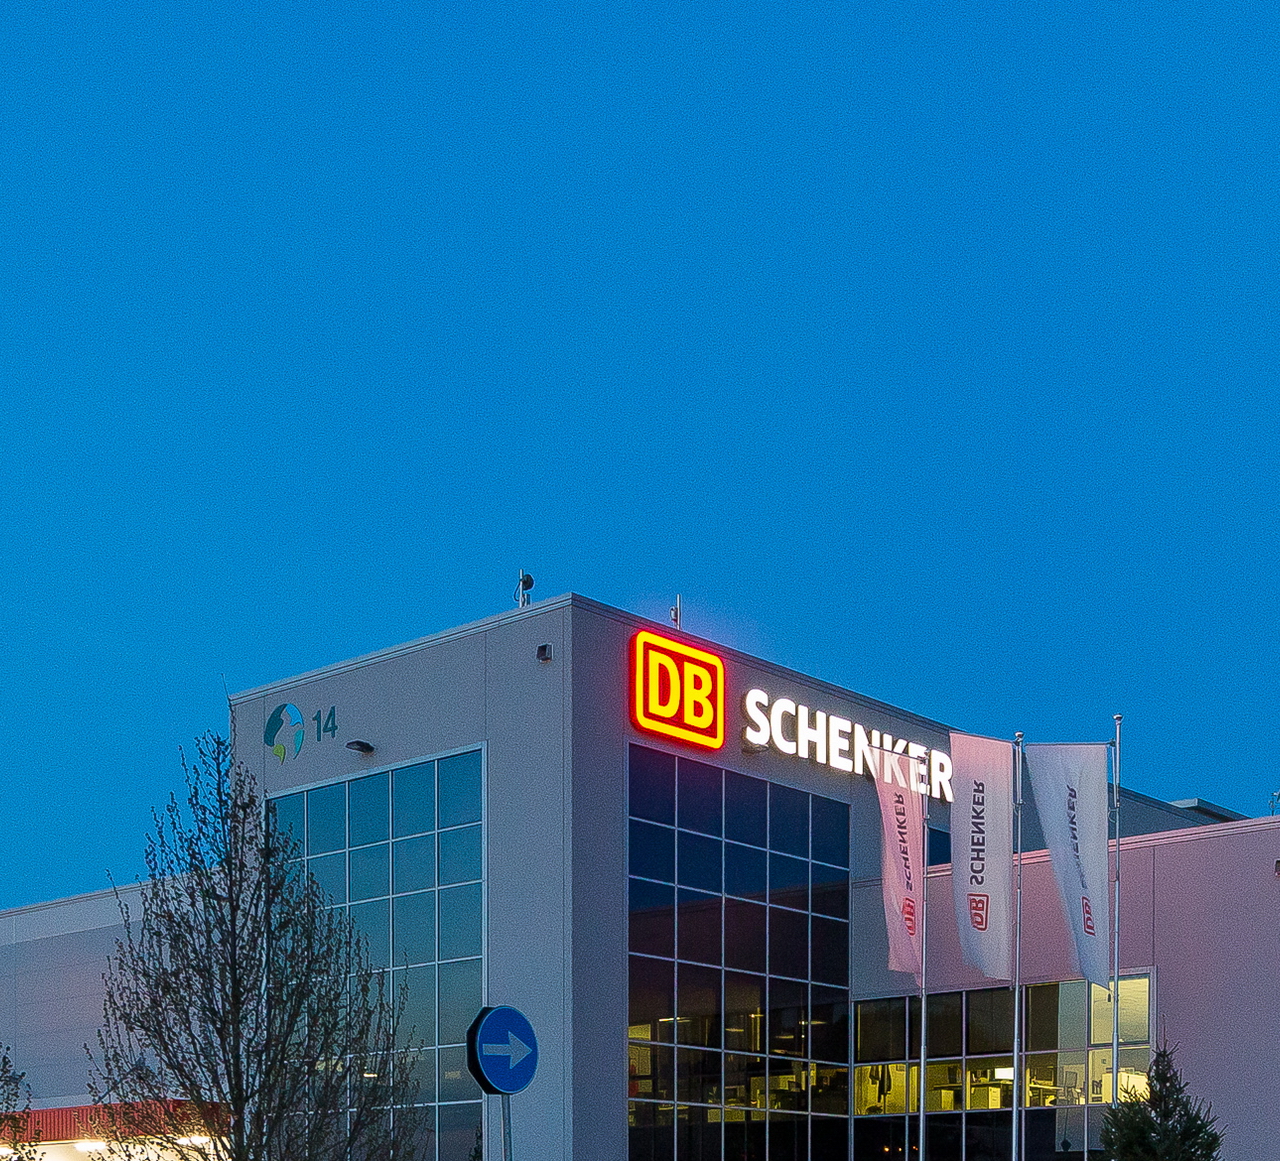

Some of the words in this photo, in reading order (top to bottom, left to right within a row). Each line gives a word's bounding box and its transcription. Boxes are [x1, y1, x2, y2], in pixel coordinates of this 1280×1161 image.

[311, 705, 339, 742] 14
[646, 647, 716, 732] DB
[745, 688, 954, 803] SCHENKER
